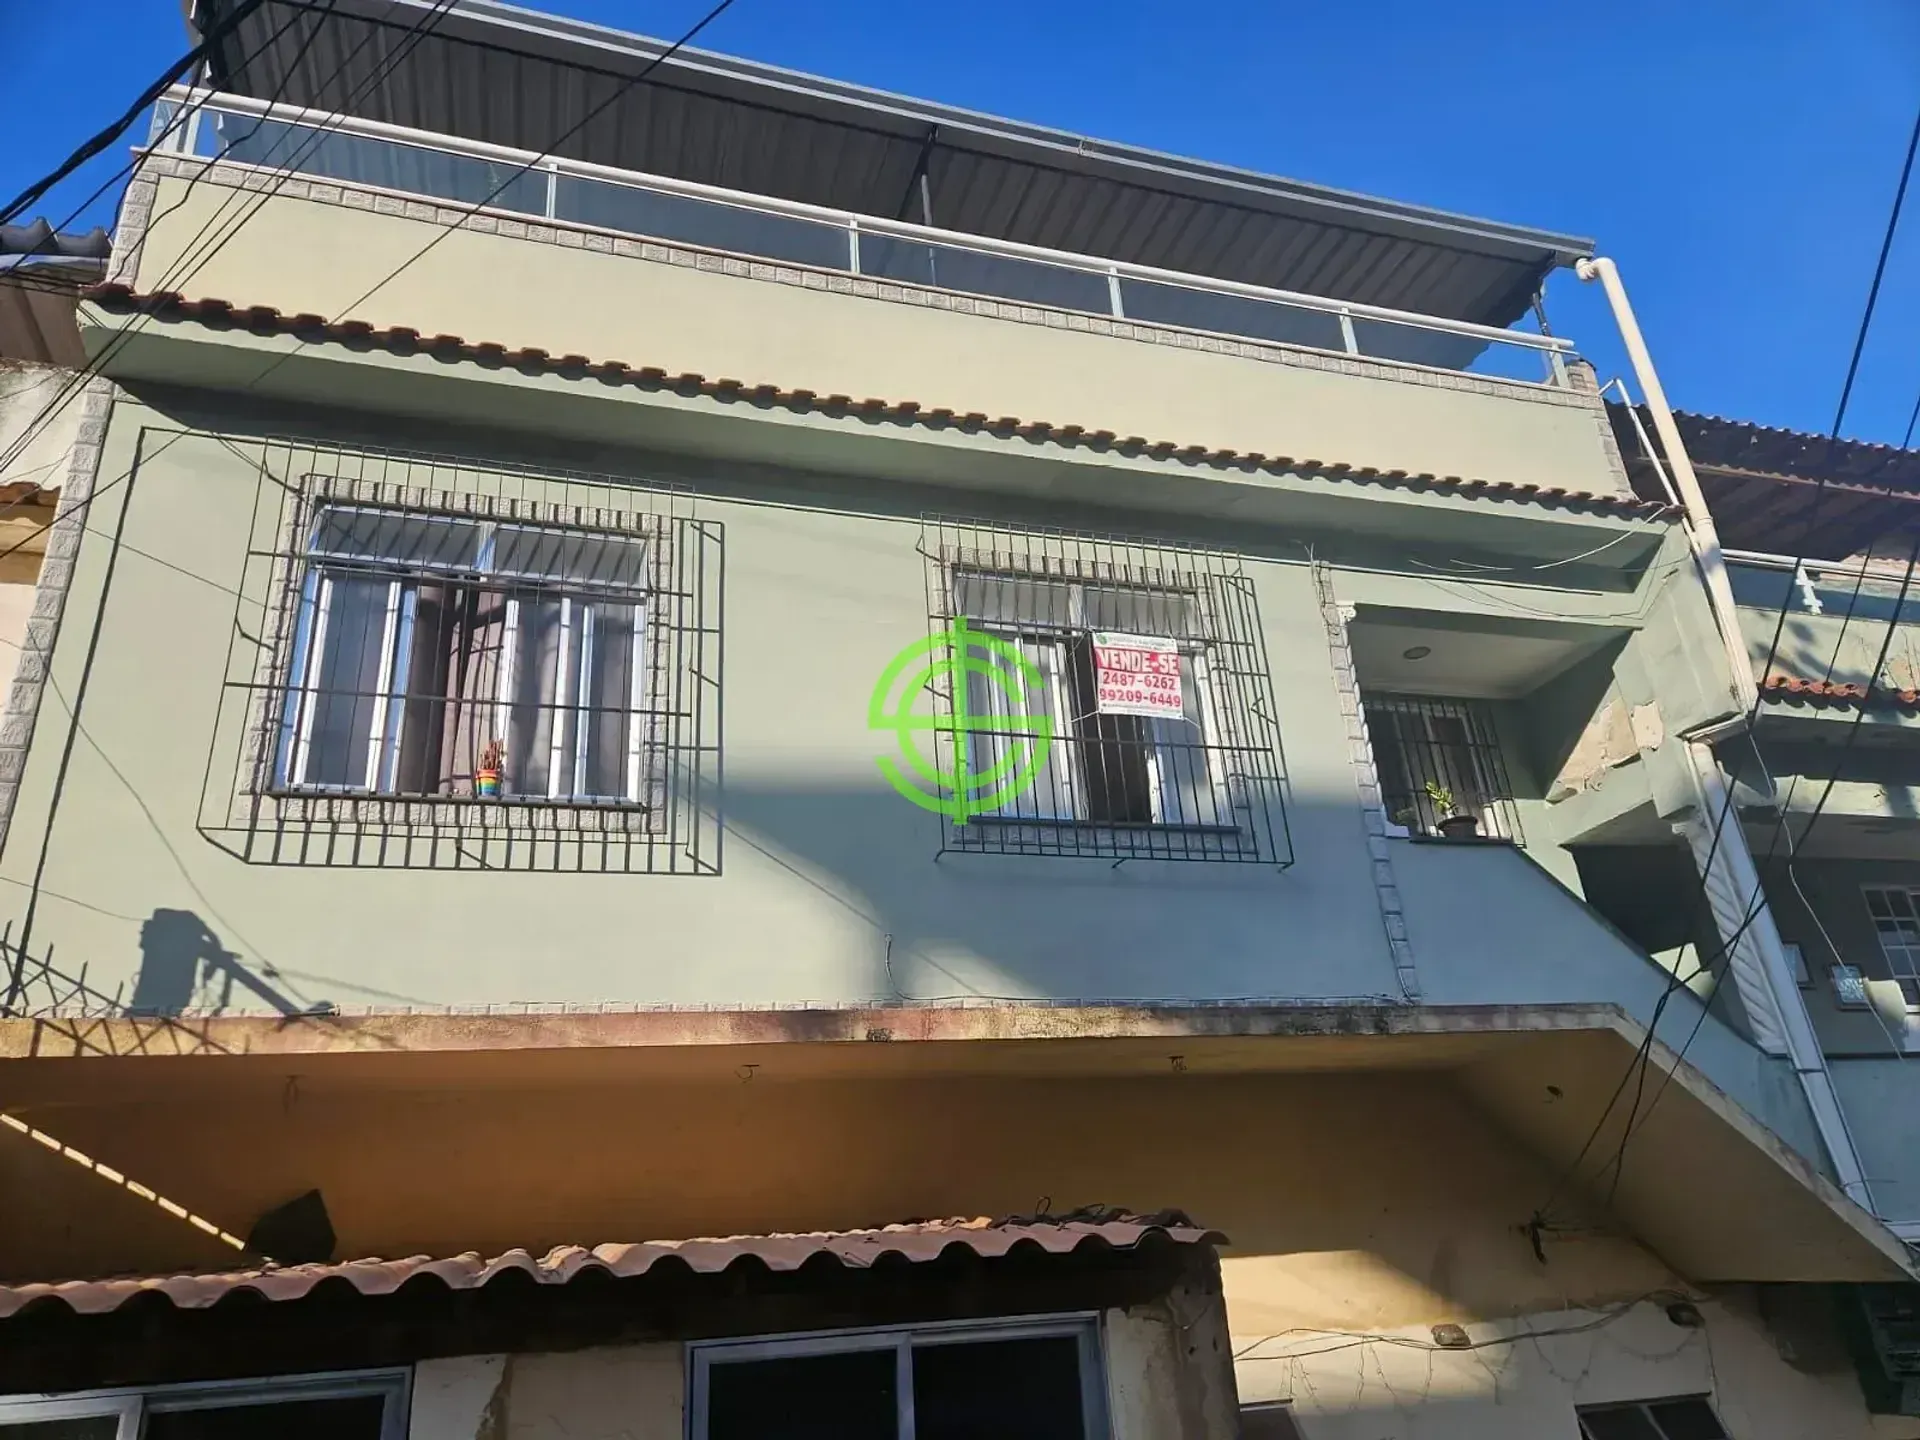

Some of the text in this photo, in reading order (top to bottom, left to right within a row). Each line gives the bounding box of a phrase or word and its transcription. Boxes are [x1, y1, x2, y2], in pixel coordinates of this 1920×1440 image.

[1098, 648, 1178, 675] VENDE-SE
[1102, 671, 1176, 690] 2487-6262
[1099, 688, 1181, 707] 99209-6449
